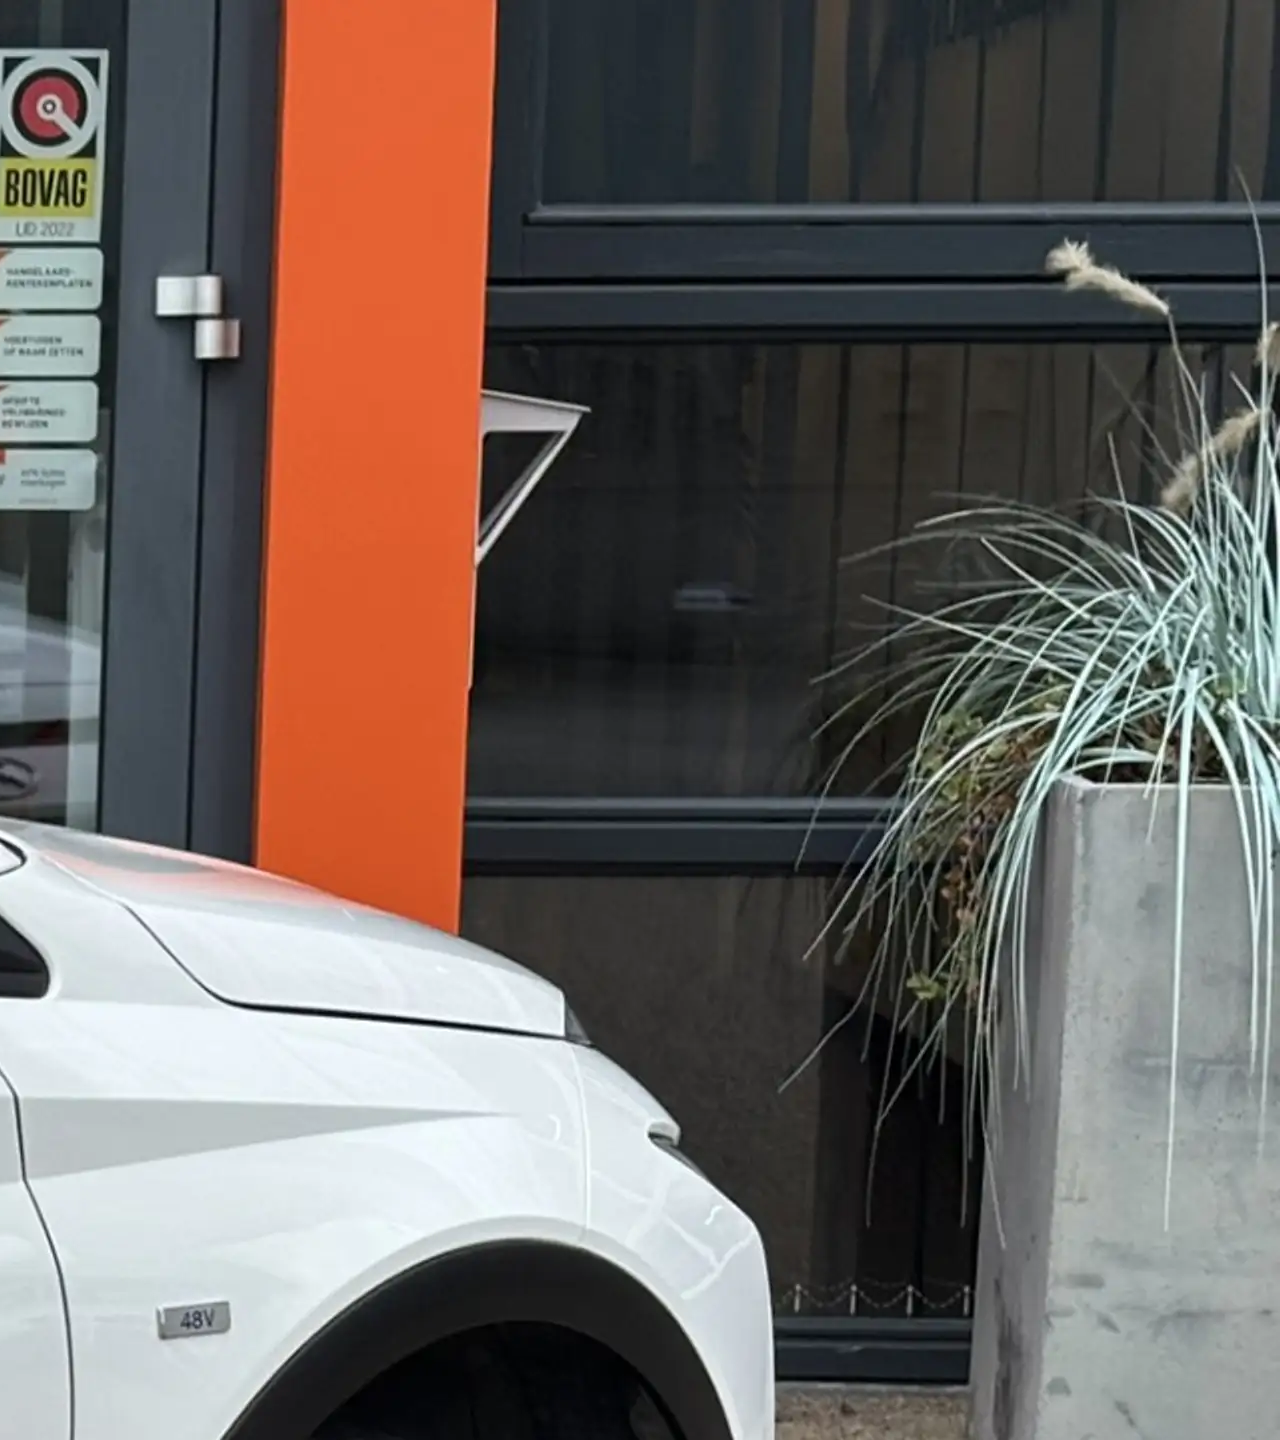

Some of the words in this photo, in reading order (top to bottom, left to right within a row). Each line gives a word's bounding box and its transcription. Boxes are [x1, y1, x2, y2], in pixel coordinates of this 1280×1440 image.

[5, 168, 88, 208] BOVAG
[15, 222, 36, 237] LID
[180, 1308, 215, 1330] 48V
